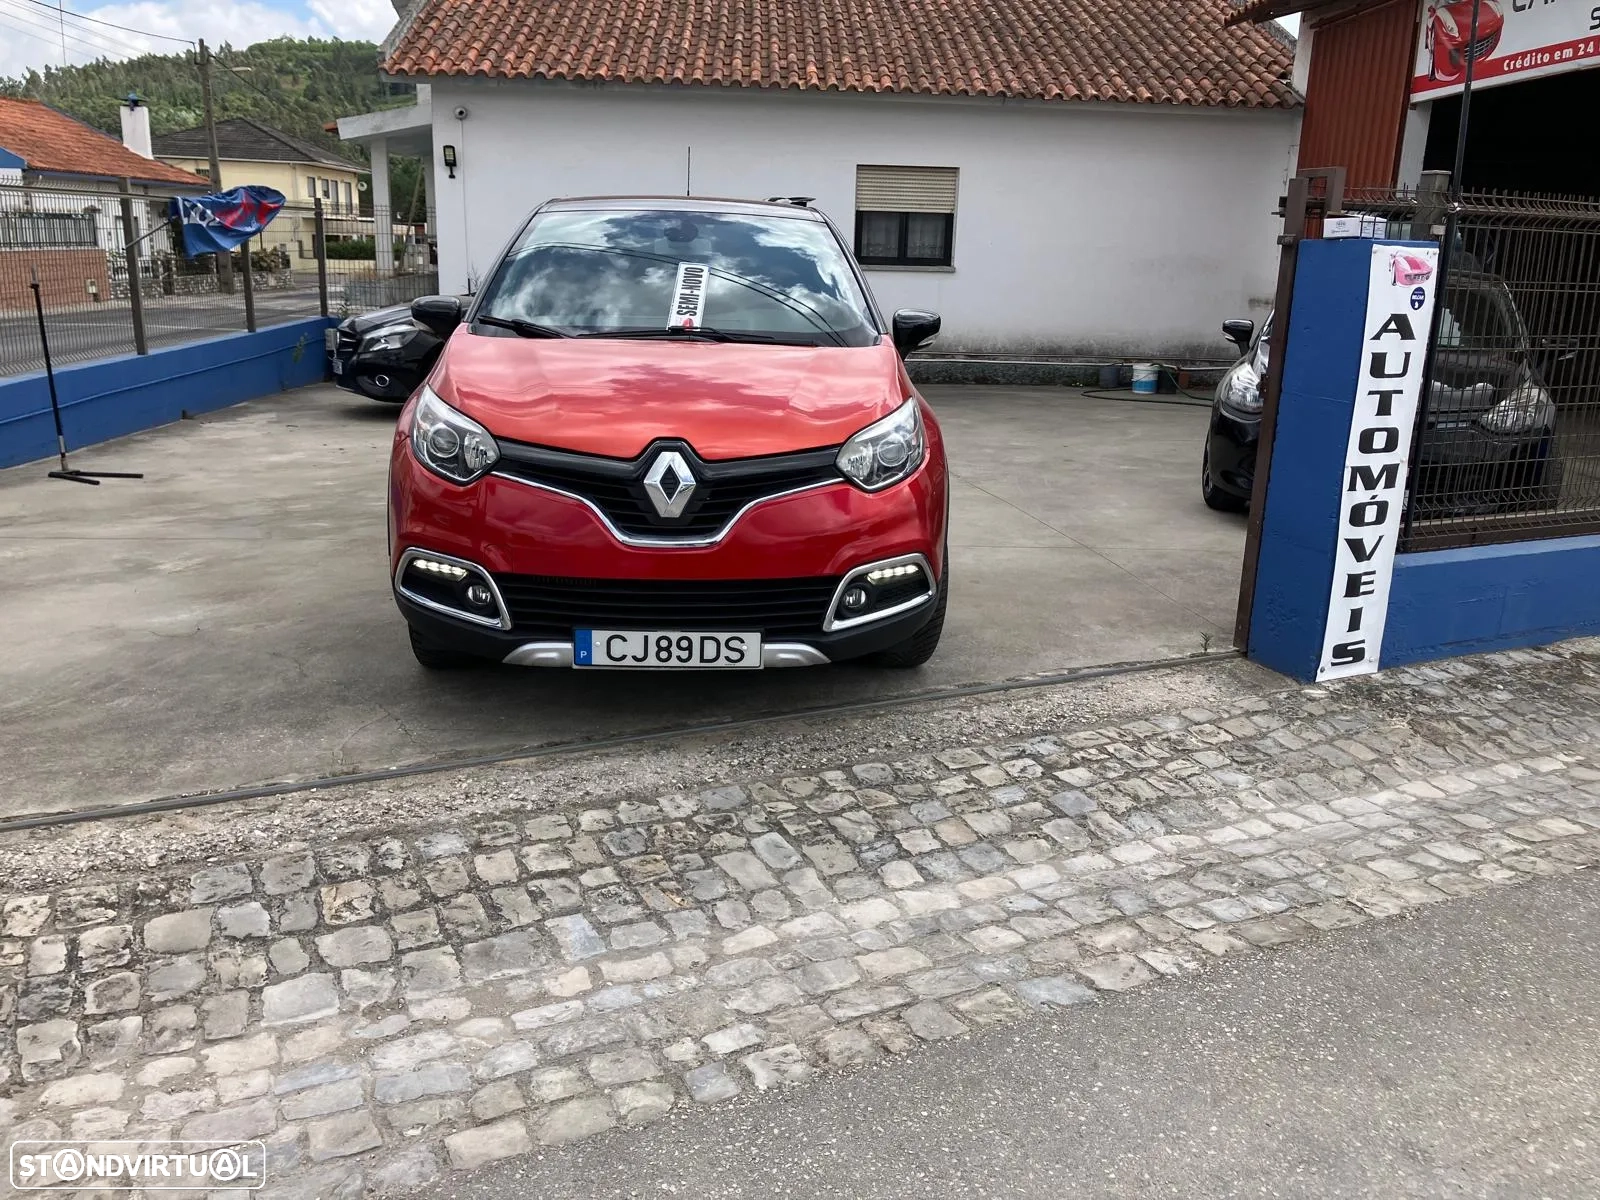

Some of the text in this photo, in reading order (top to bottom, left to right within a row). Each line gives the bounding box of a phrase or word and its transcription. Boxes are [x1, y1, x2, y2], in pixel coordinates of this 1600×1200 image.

[1503, 52, 1550, 71] Crédito
[1554, 47, 1573, 61] em
[1577, 41, 1594, 56] 24
[676, 266, 704, 317] SEMI-NOVO
[1330, 313, 1416, 667] AUTOMÓVEIS
[580, 634, 746, 664] P CJ89DS
